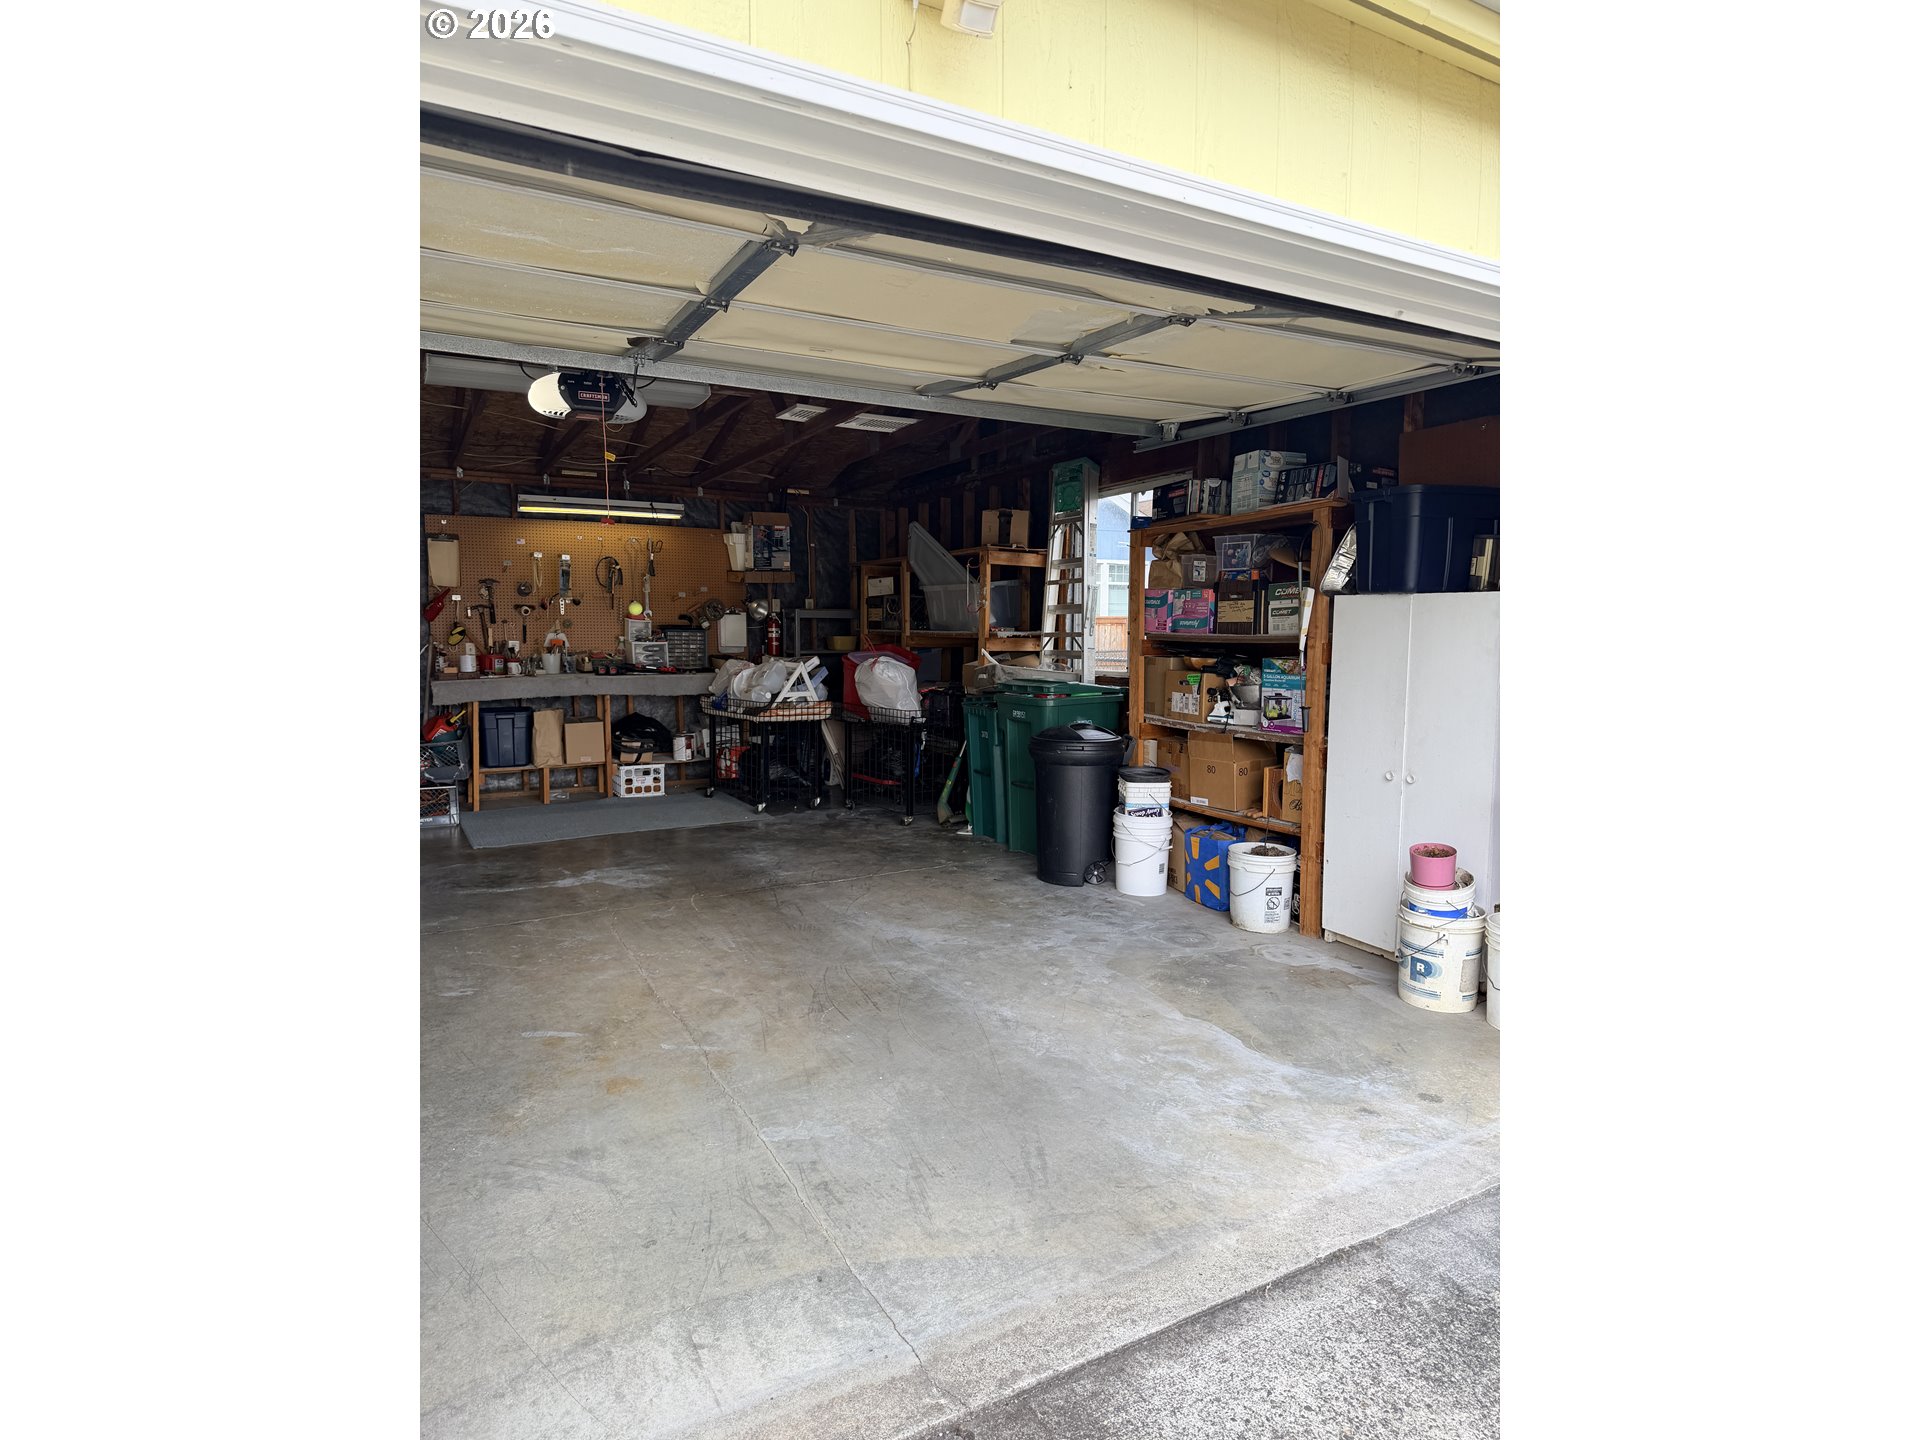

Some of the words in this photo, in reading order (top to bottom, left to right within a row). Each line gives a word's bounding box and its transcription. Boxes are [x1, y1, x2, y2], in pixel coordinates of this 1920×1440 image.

[1275, 587, 1299, 596] COME
[1206, 765, 1216, 774] 80
[1238, 767, 1248, 776] 80
[1416, 963, 1425, 972] R
